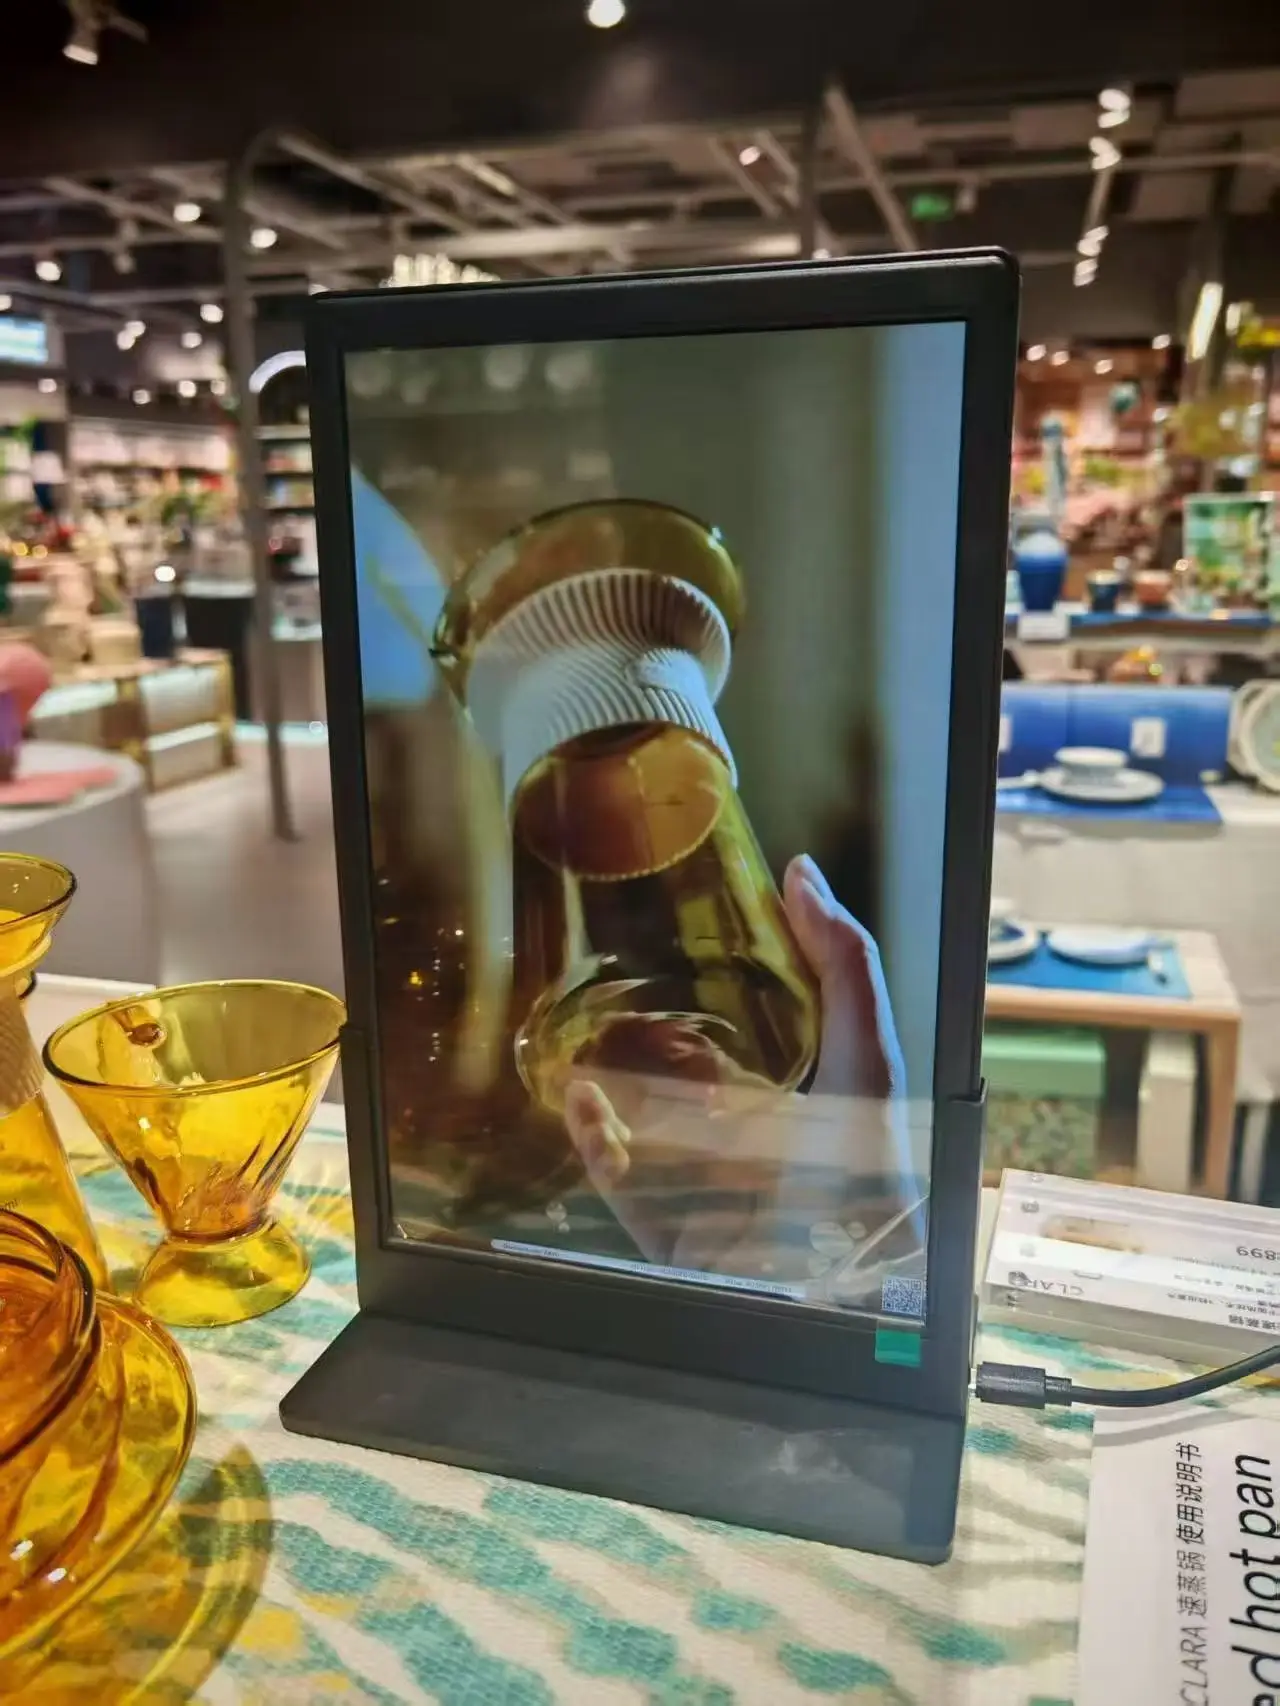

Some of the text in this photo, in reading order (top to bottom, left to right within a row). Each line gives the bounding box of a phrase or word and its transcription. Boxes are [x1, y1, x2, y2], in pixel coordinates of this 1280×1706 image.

[1235, 1454, 1280, 1540] pan
[1176, 1442, 1209, 1706] CLARA 速蒸锅 使用说明书
[1228, 1548, 1280, 1634] hot
